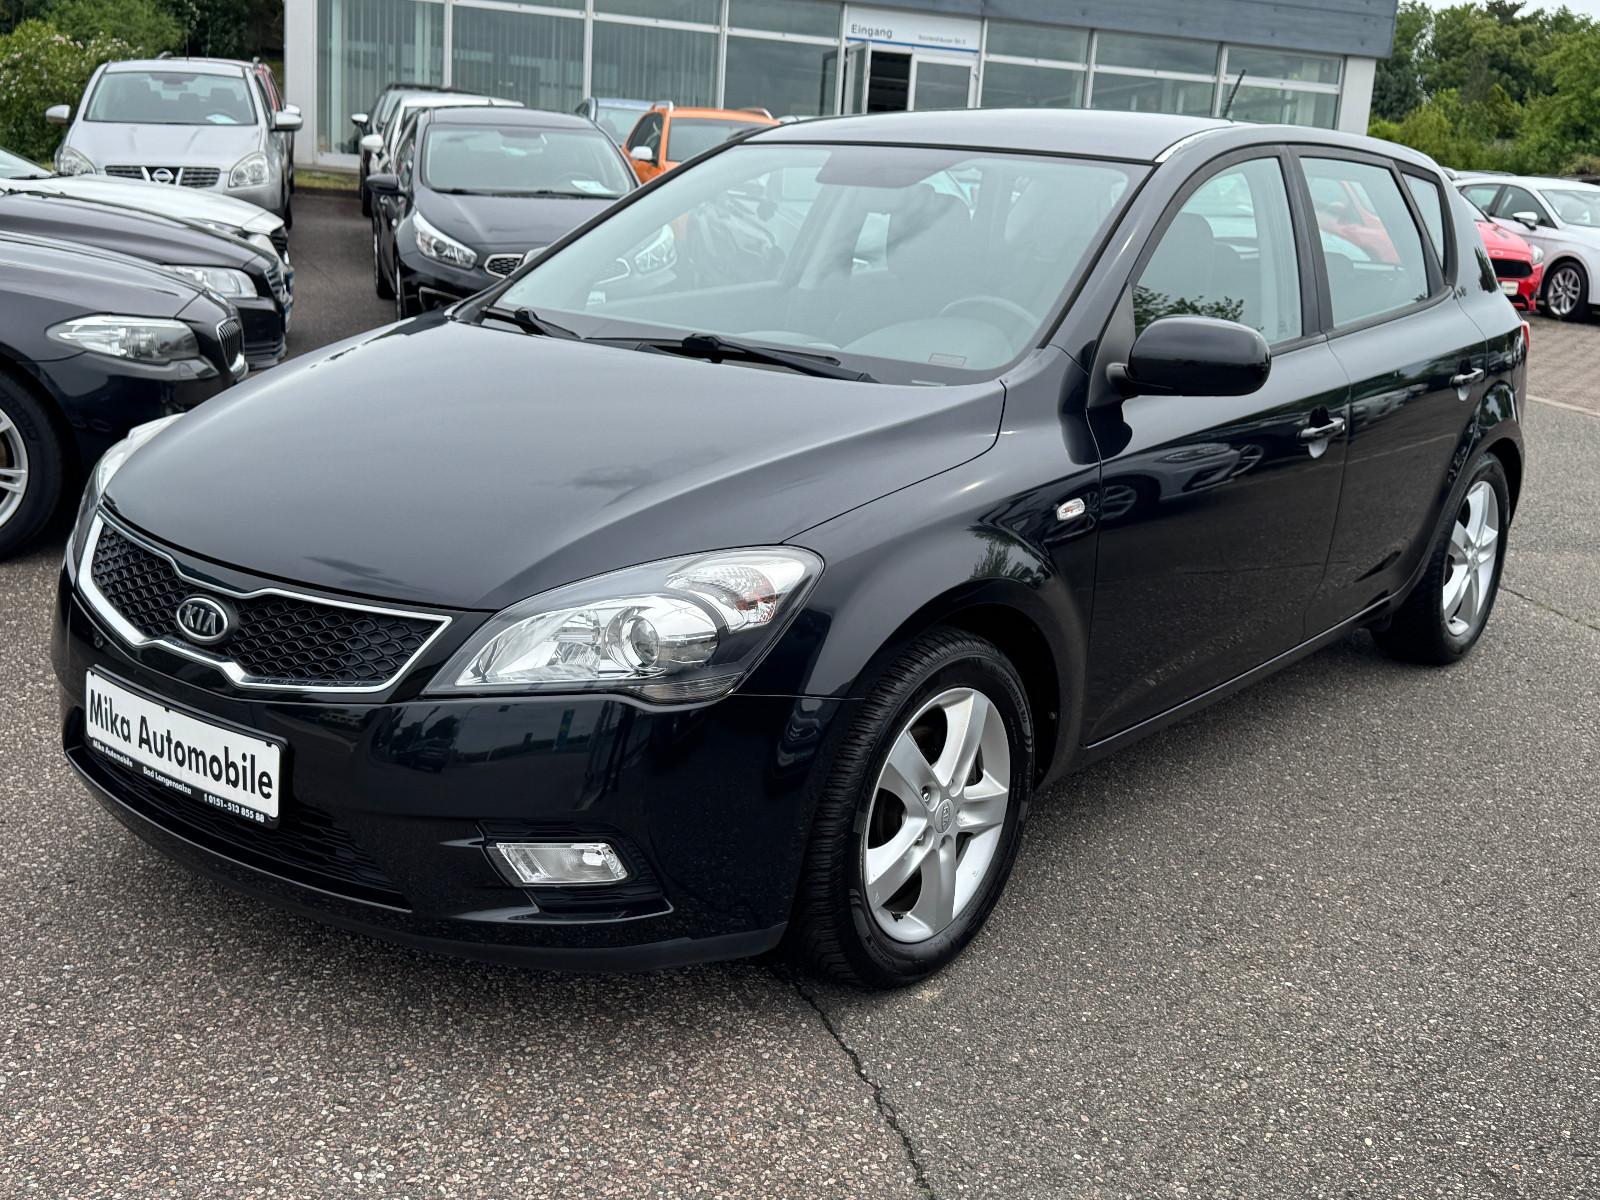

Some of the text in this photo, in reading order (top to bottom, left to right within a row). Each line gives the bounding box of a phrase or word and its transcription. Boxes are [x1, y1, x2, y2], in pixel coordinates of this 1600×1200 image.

[850, 23, 893, 39] Eingang
[183, 604, 217, 635] KIA
[89, 689, 273, 800] Mika Automobile
[142, 766, 155, 778] Bad
[155, 773, 192, 795] Langensalza
[208, 794, 240, 814] 0151-513
[240, 806, 255, 820] 855
[255, 812, 265, 823] 88
